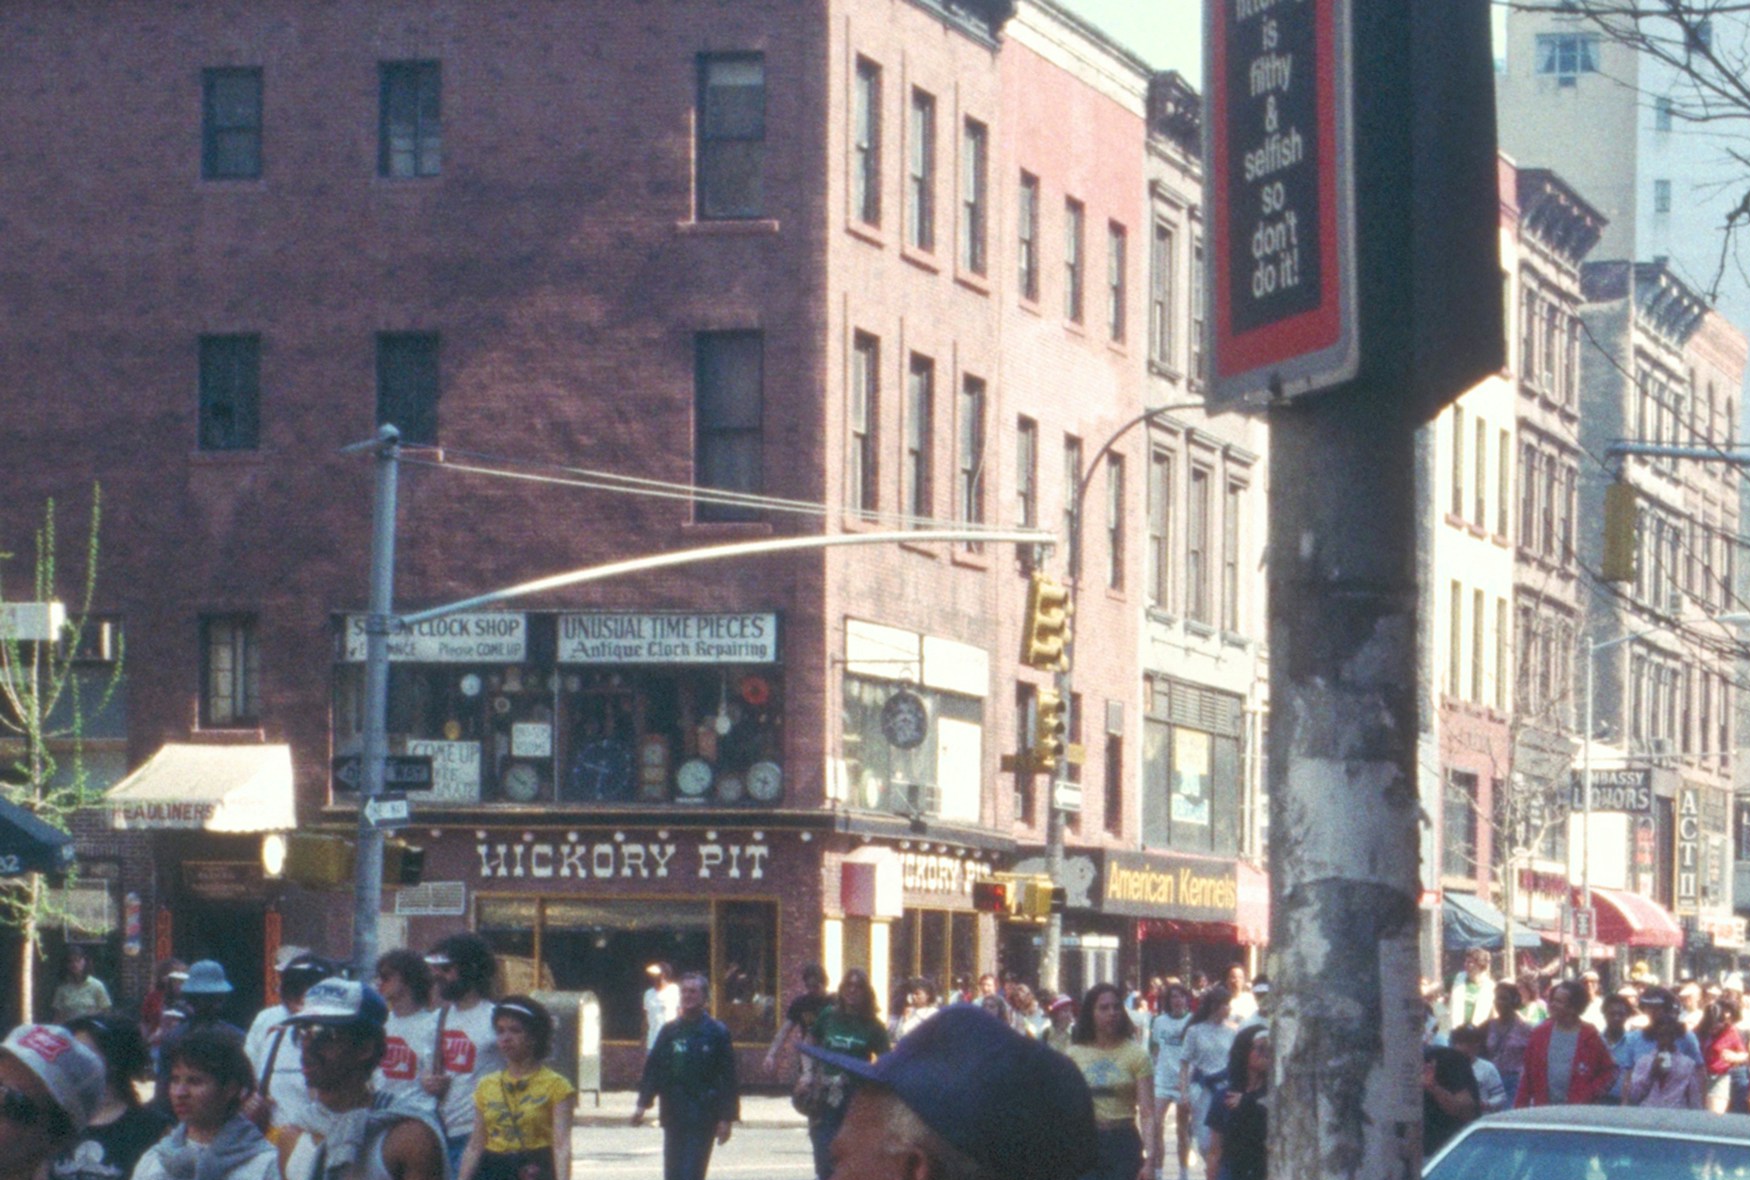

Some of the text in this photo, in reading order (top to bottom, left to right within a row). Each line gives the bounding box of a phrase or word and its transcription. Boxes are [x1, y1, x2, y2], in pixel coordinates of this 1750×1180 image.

[1261, 13, 1279, 51] is
[1249, 52, 1293, 98] filthy
[1265, 95, 1279, 131] &
[1243, 127, 1304, 182] selfish
[1261, 182, 1285, 215] so
[1251, 211, 1298, 259] don't
[1252, 249, 1300, 299] do it!
[417, 618, 470, 637] CLOCK
[475, 618, 520, 636] SHOP
[564, 616, 765, 639] UNUSUAL TIME PIECES
[438, 642, 474, 656] Please
[476, 642, 504, 656] COME
[506, 642, 521, 656] UP
[570, 640, 768, 659] Antique Clock Repairing
[1572, 787, 1649, 810] LQUORS
[477, 844, 769, 878] HICKORY PIT
[1108, 861, 1237, 909] American Kennels
